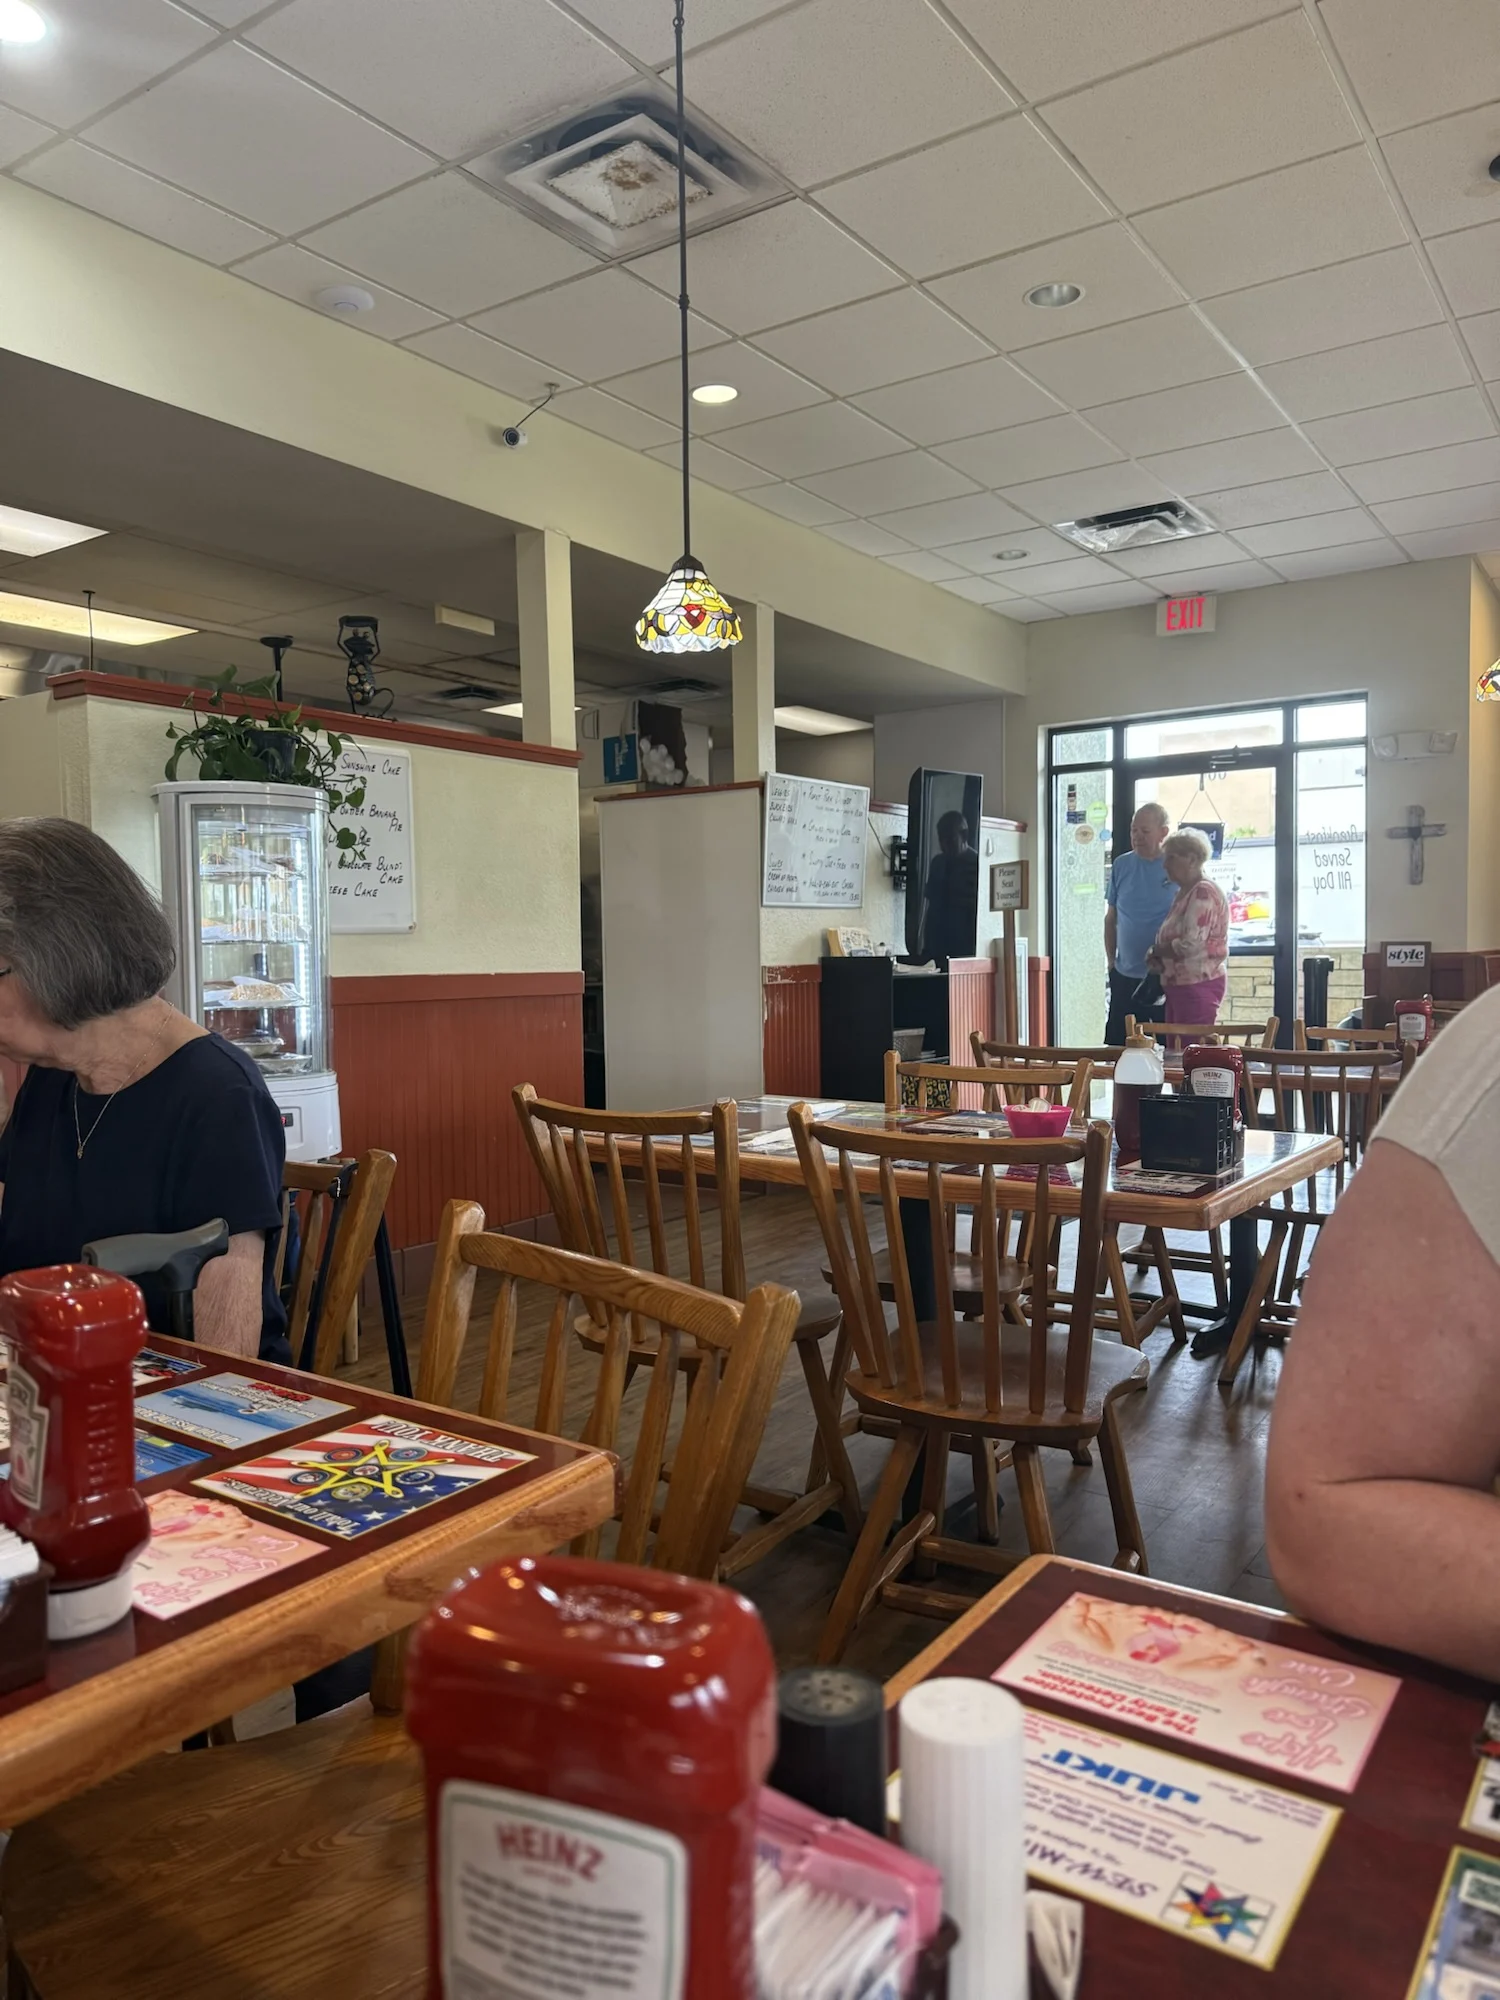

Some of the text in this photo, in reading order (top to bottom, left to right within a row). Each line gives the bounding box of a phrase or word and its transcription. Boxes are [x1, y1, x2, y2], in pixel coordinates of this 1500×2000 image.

[1166, 596, 1206, 631] EXIT
[382, 759, 402, 775] CAKE
[389, 818, 403, 832] PIE
[380, 873, 403, 884] CAKE
[354, 881, 379, 898] CAKE
[1388, 948, 1424, 964] style
[431, 1435, 511, 1462] THANK
[1052, 1749, 1201, 1805] JUKI
[496, 1822, 606, 1882] HEINZ
